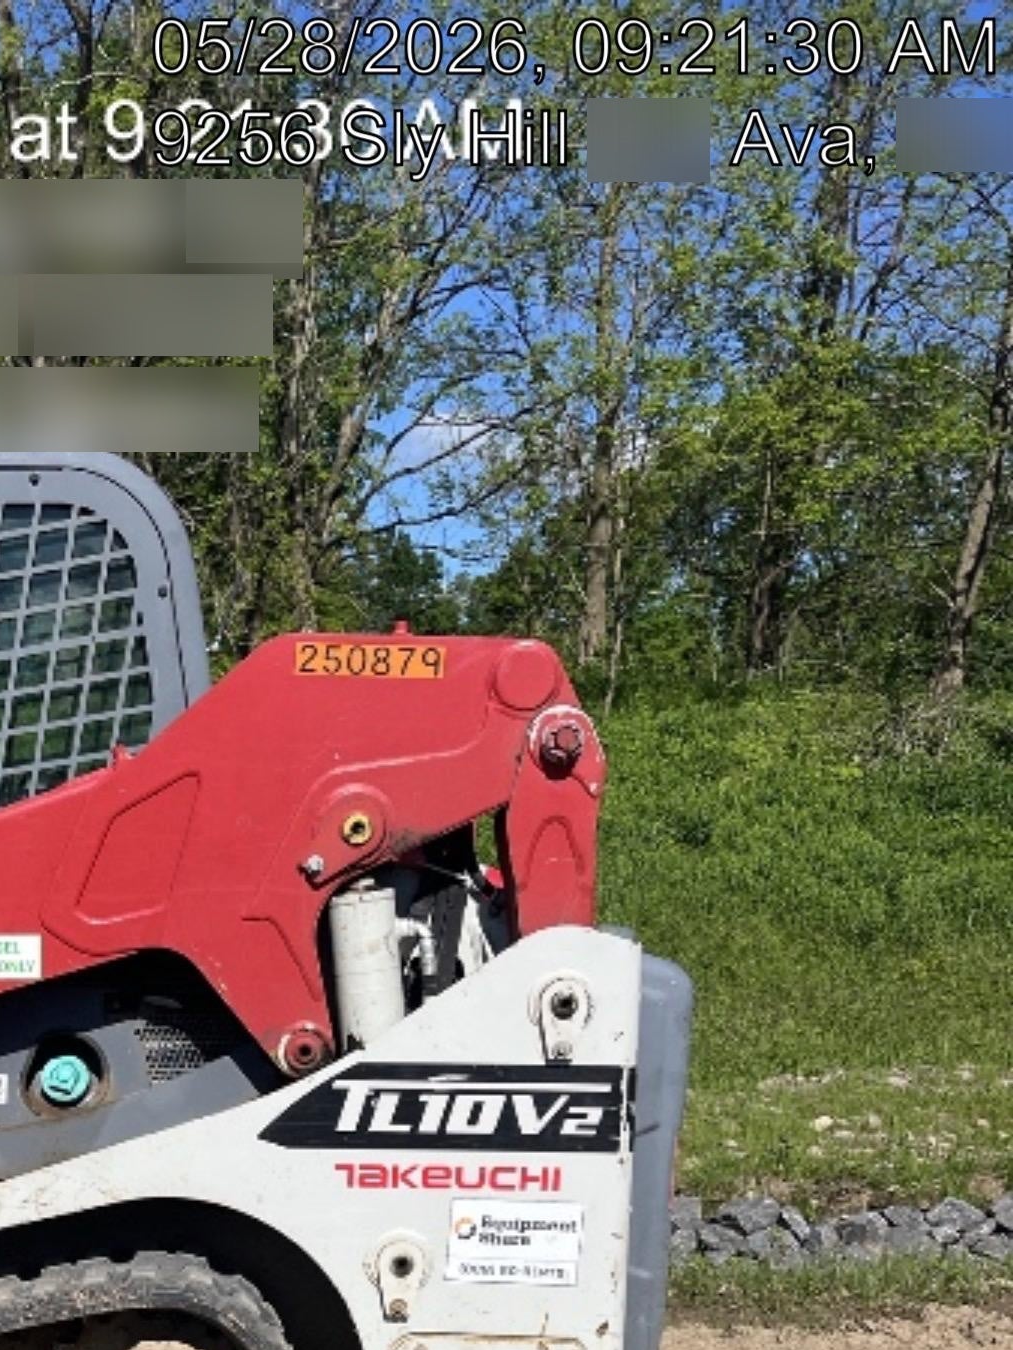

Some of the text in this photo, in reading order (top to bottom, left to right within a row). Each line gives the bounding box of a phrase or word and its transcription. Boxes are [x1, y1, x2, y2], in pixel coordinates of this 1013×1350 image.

[298, 644, 442, 677] 250879
[331, 1079, 612, 1136] TL10V2
[481, 1214, 577, 1234] Equipment
